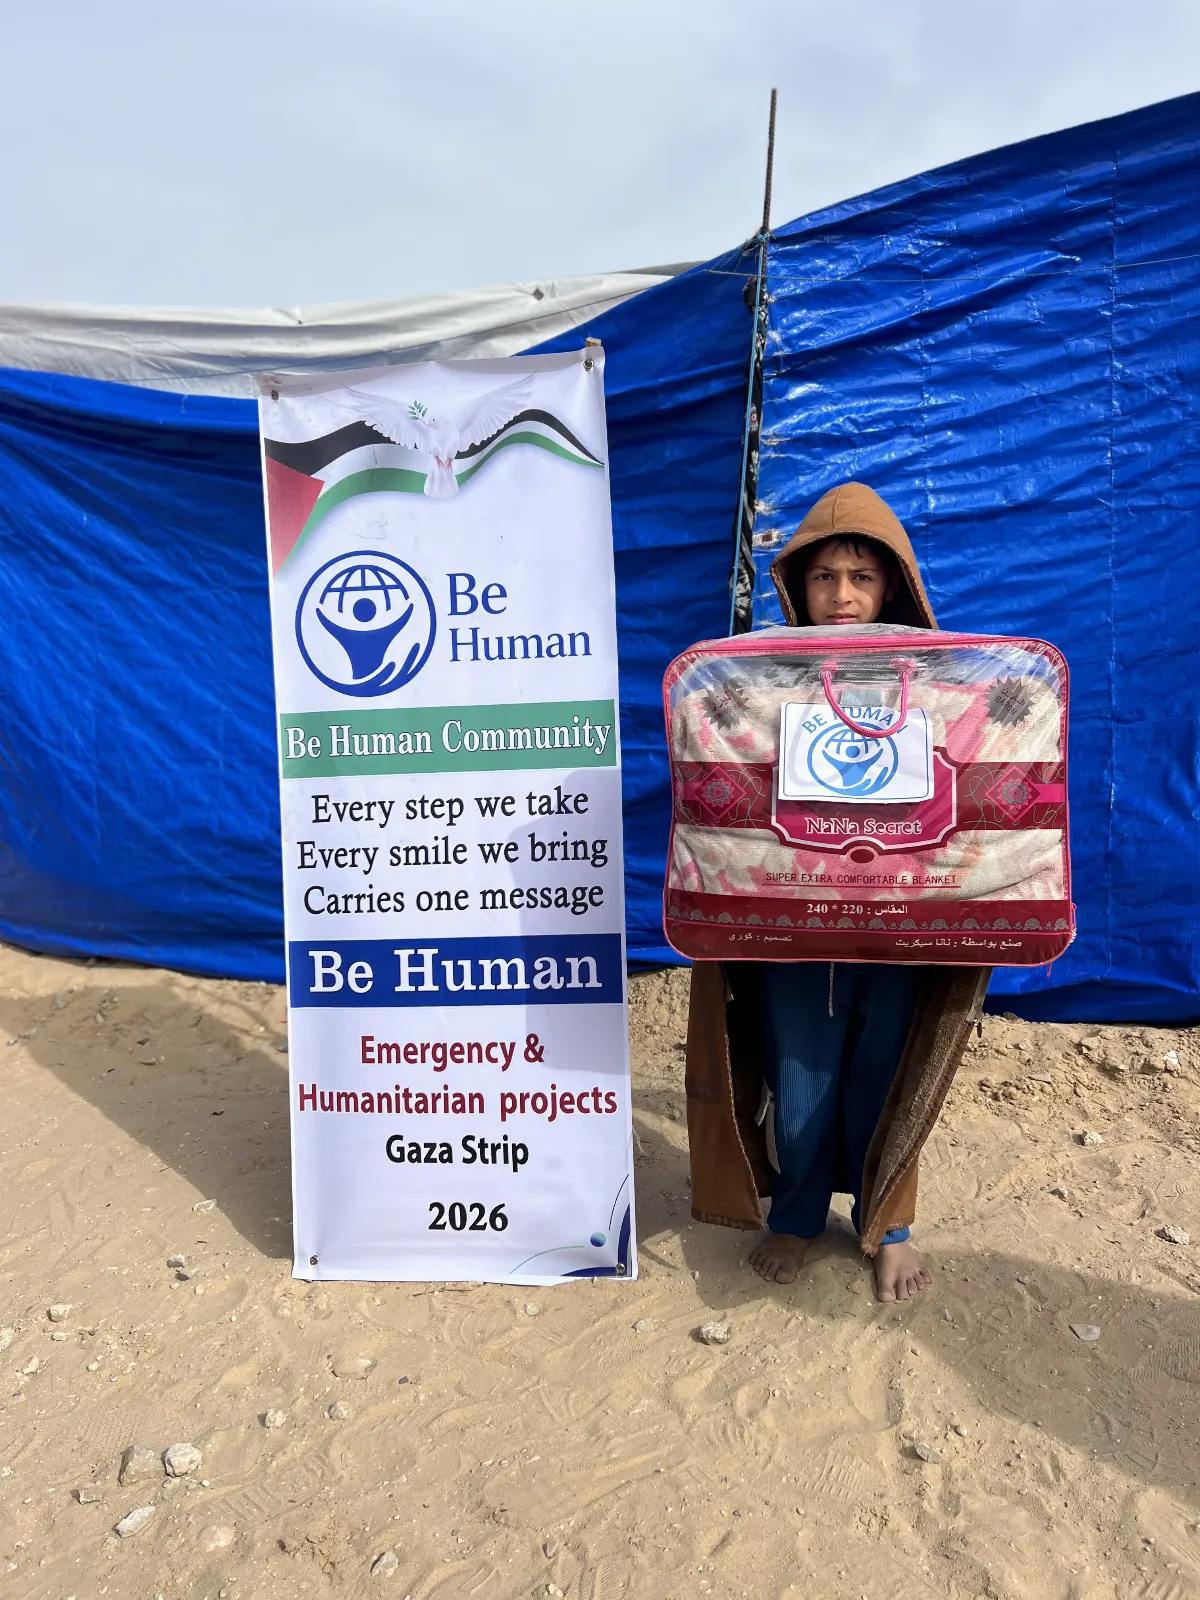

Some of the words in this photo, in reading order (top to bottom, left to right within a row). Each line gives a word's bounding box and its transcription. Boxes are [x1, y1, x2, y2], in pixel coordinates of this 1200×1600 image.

[445, 572, 508, 616] Be
[448, 627, 593, 662] Human
[285, 727, 322, 759] Be
[328, 725, 434, 757] Human
[441, 715, 612, 755] Community
[801, 713, 828, 735] BE
[311, 795, 395, 828] Every
[405, 796, 465, 826] step
[475, 795, 516, 817] we
[526, 786, 589, 815] take
[805, 818, 860, 835] NaNa
[863, 818, 923, 835] Secret
[297, 841, 379, 875] Every
[389, 836, 468, 866] smile
[477, 842, 519, 864] we
[528, 833, 609, 868] bring
[766, 872, 797, 882] SUPER
[801, 873, 833, 884] EXTRA
[837, 874, 908, 885] COMFORTABLE
[303, 884, 405, 915] Carries
[415, 889, 469, 912] one
[479, 884, 604, 915] message
[806, 903, 828, 914] 240
[841, 904, 864, 914] 220
[875, 904, 908, 915] المقاس
[999, 938, 1022, 949] صنع
[308, 950, 374, 994] Be
[394, 948, 603, 992] Human
[360, 1034, 516, 1072] Emergency
[523, 1033, 545, 1063] &
[298, 1083, 485, 1115] Humanitarian
[500, 1084, 618, 1122] projects
[385, 1134, 453, 1164] Gaza
[461, 1134, 529, 1172] Strip
[428, 1201, 509, 1232] 2026
